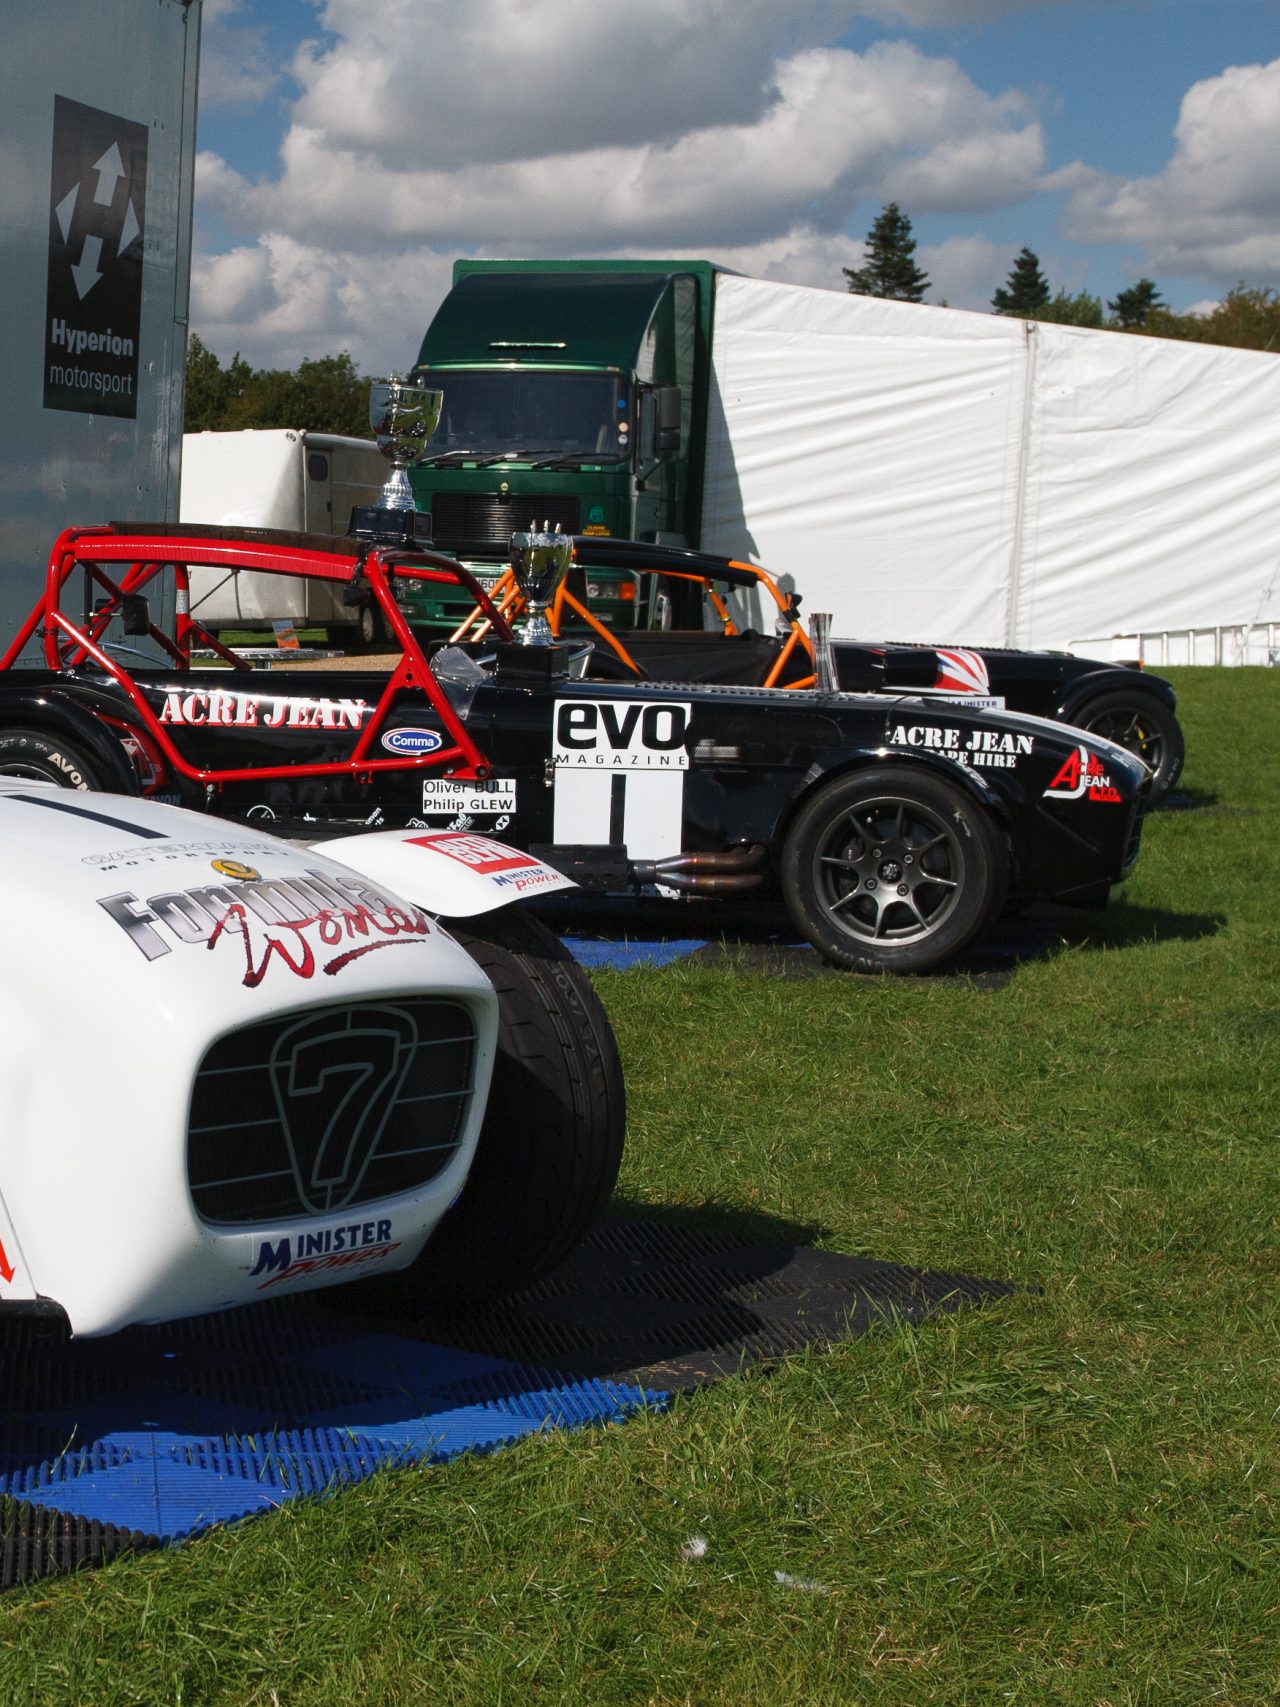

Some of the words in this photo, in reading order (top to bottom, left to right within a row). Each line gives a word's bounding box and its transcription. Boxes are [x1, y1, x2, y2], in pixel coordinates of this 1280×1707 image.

[52, 318, 134, 356] Hyperion
[50, 363, 132, 396] motorsport
[160, 694, 259, 726] ACRE
[263, 697, 366, 730] JEAN
[557, 703, 686, 751] evo
[392, 734, 435, 747] Comma
[890, 726, 960, 749] ACRE
[966, 731, 1034, 755] JEAN
[556, 755, 685, 766] MAGAZINE
[974, 754, 1016, 768] HIRE
[424, 781, 468, 793] Oliver
[475, 781, 514, 793] BULL
[424, 799, 465, 811] Philip
[470, 800, 513, 809] GLEW
[81, 842, 280, 864] CATERHAM
[100, 850, 290, 871] MOTORSPORT
[491, 869, 544, 886] MINISTER
[514, 874, 560, 891] POWER
[96, 869, 394, 961] Formula
[249, 1219, 392, 1276] MINISTER
[256, 1242, 402, 1290] POWER
